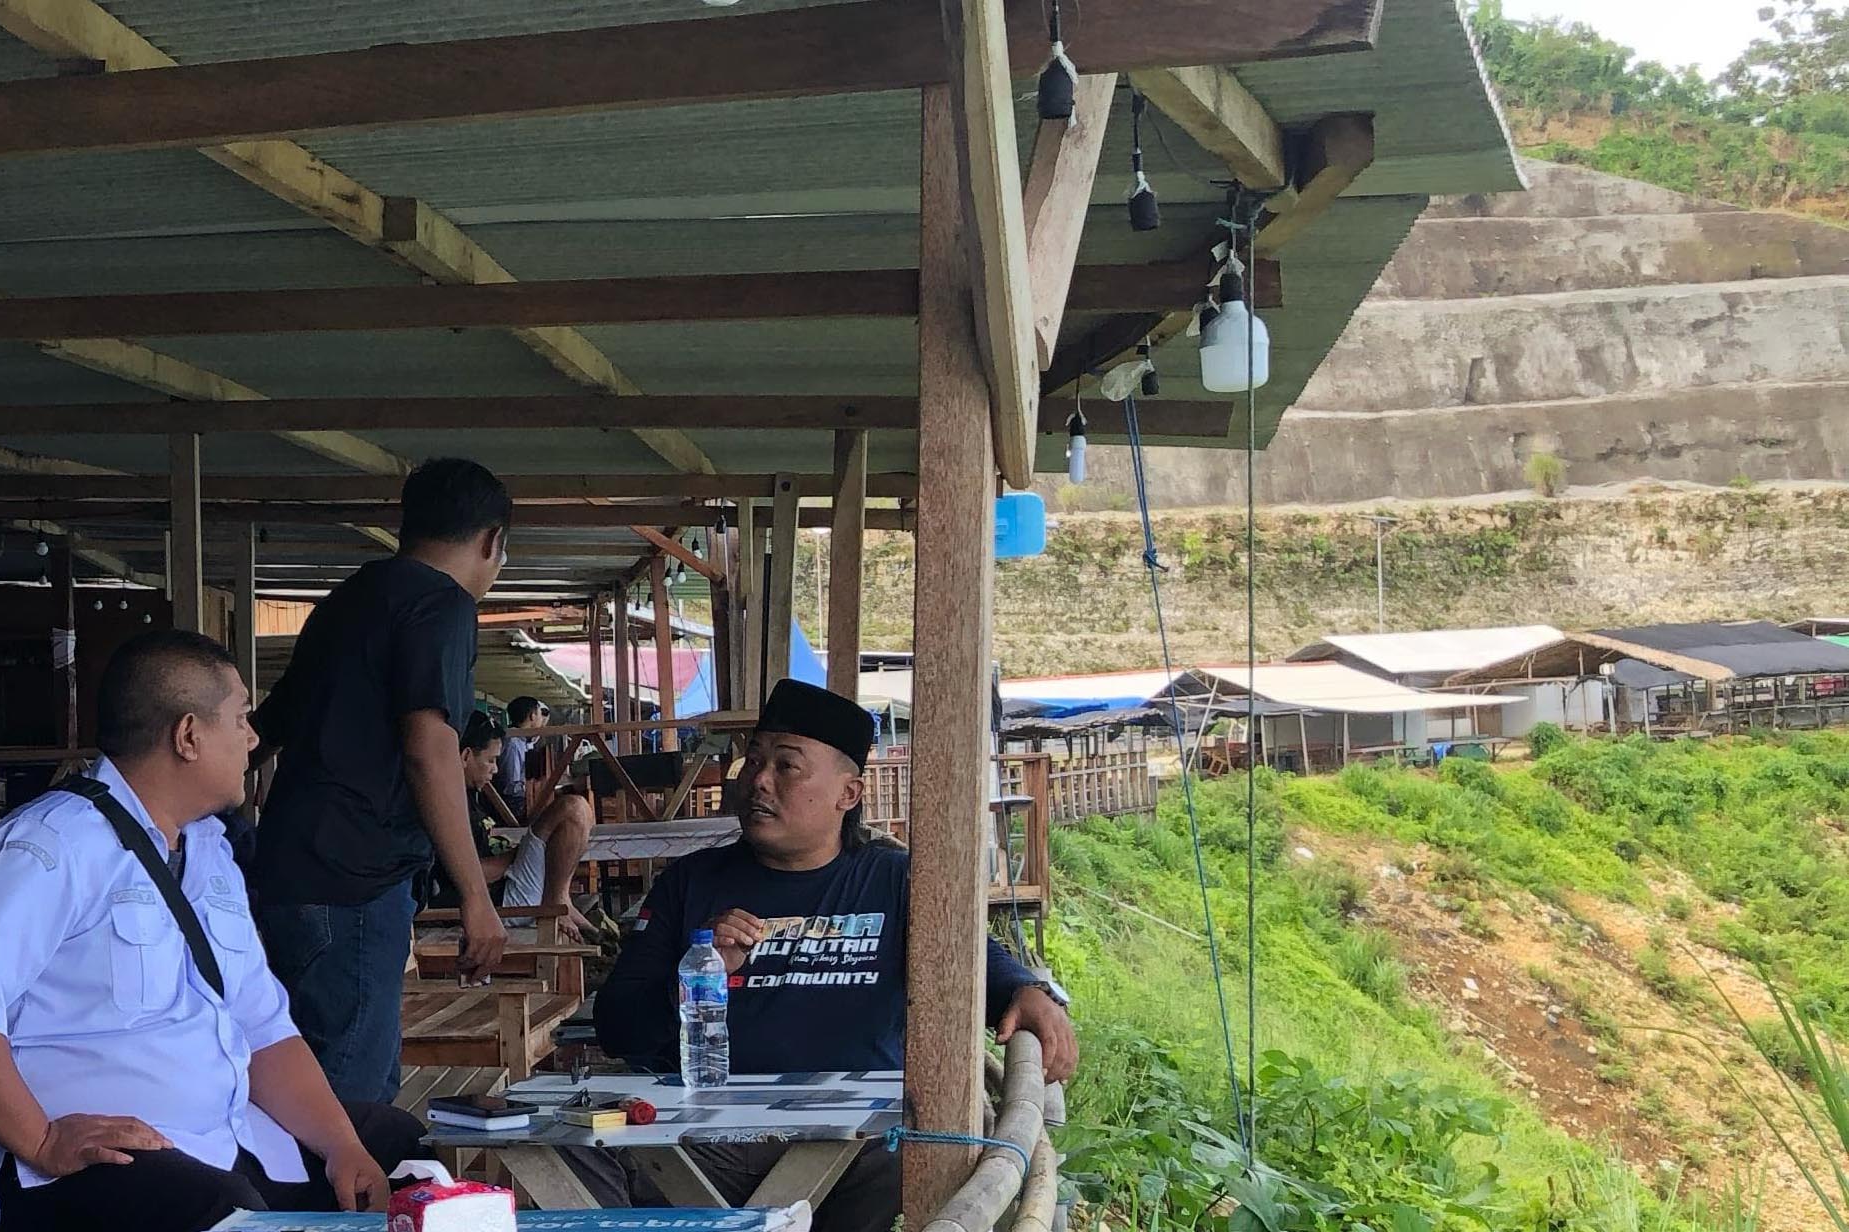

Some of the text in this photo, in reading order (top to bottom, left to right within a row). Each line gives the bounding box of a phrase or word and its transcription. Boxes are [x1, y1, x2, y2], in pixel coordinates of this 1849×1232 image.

[759, 913, 885, 939] MUDA
[794, 937, 880, 955] HUTAN
[747, 971, 880, 988] COMMUNITY
